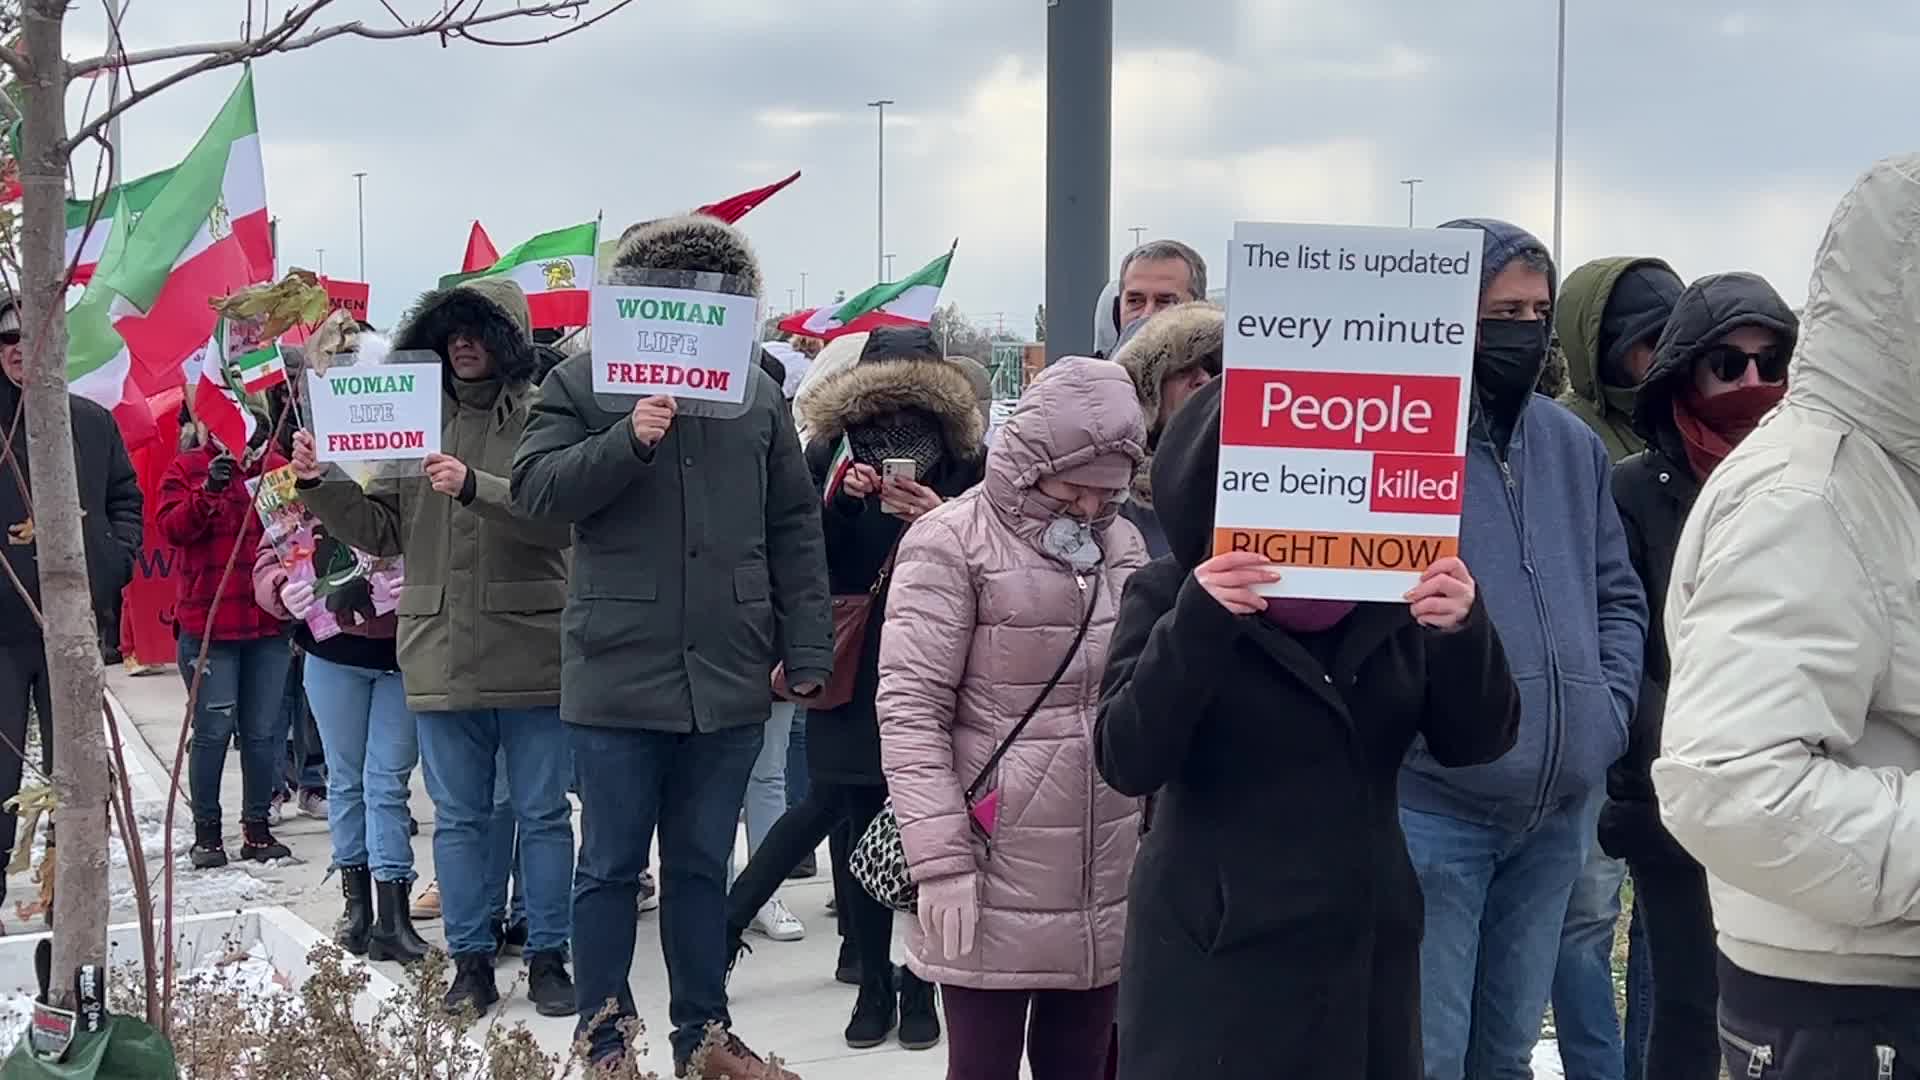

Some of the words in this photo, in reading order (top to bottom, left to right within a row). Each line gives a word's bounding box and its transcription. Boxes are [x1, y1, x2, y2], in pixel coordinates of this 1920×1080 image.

[1243, 243, 1289, 270] The
[1298, 245, 1331, 271] list
[1339, 247, 1356, 272] is
[1365, 249, 1470, 277] updated
[616, 298, 727, 326] WOMAN
[637, 330, 698, 356] LIFE
[1238, 314, 1332, 347] every
[1343, 313, 1465, 345] minute
[330, 375, 415, 396] WOMAN
[607, 362, 730, 391] FREEDOM
[350, 403, 394, 423] LIFE
[1261, 382, 1432, 444] People
[327, 431, 424, 452] FREEDOM
[1222, 469, 1269, 493] are
[1280, 465, 1367, 504] being
[1377, 467, 1458, 501] killed
[1231, 532, 1338, 565] RIGHT
[1350, 537, 1441, 568] NOW
